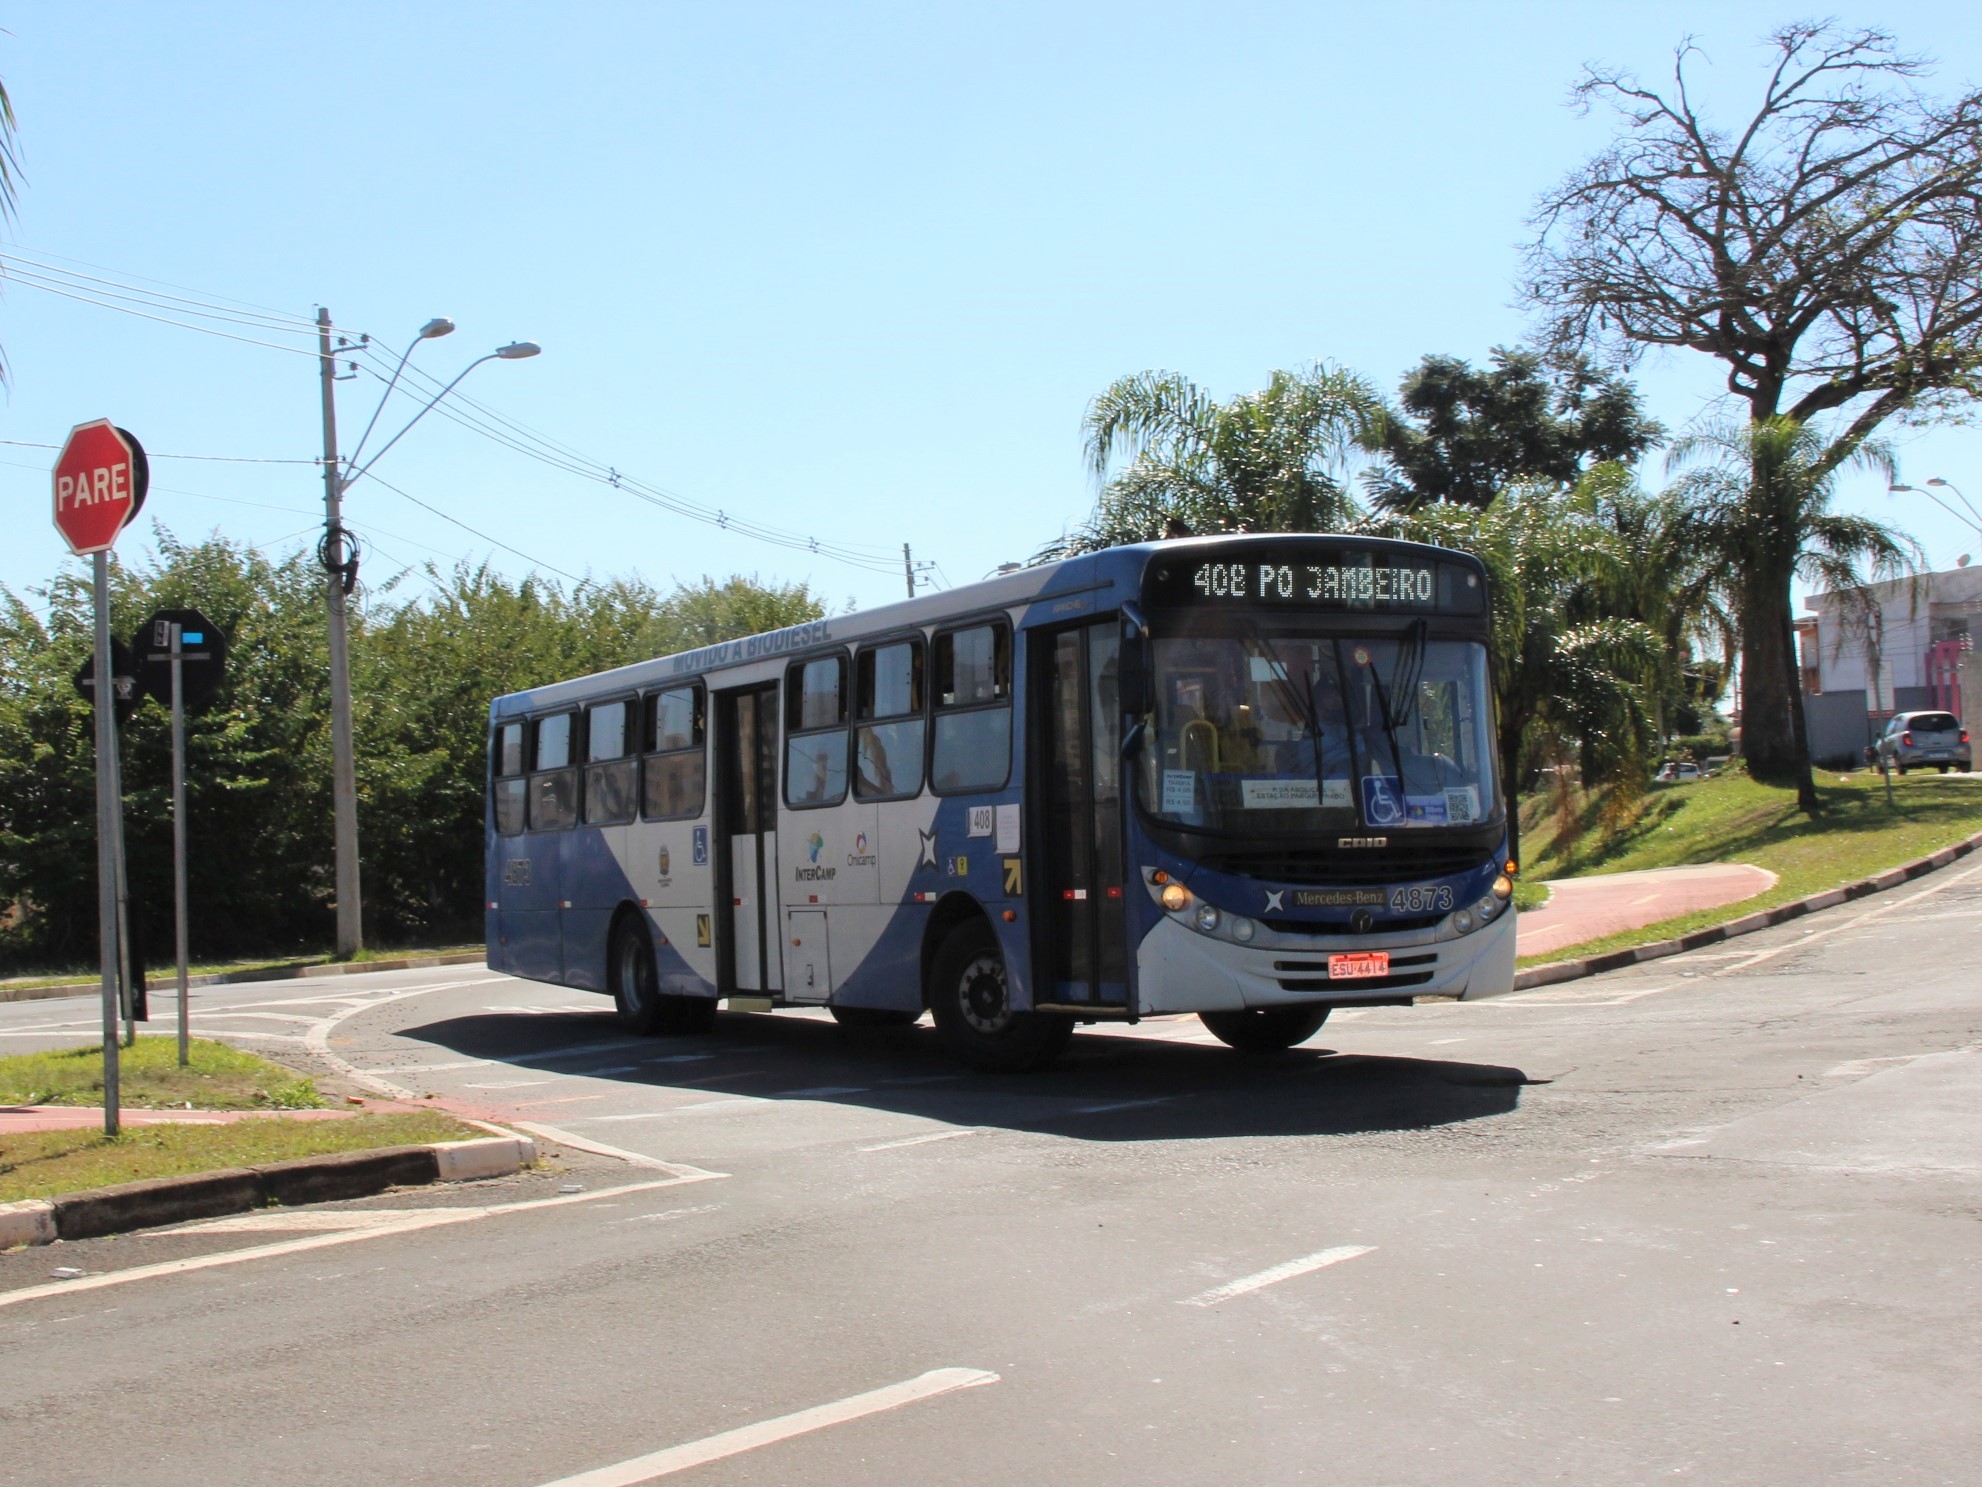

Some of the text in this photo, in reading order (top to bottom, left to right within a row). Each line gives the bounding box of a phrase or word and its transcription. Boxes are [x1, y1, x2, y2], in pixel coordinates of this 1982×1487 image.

[57, 462, 128, 512] PARE
[1307, 566, 1432, 600] JAMBEIRO
[673, 620, 832, 673] MOVIDO A BIODIESEL
[974, 810, 990, 830] 408
[1338, 837, 1387, 848] CAIO
[1297, 890, 1384, 905] Mercedes-Benz
[1390, 885, 1454, 912] 4873
